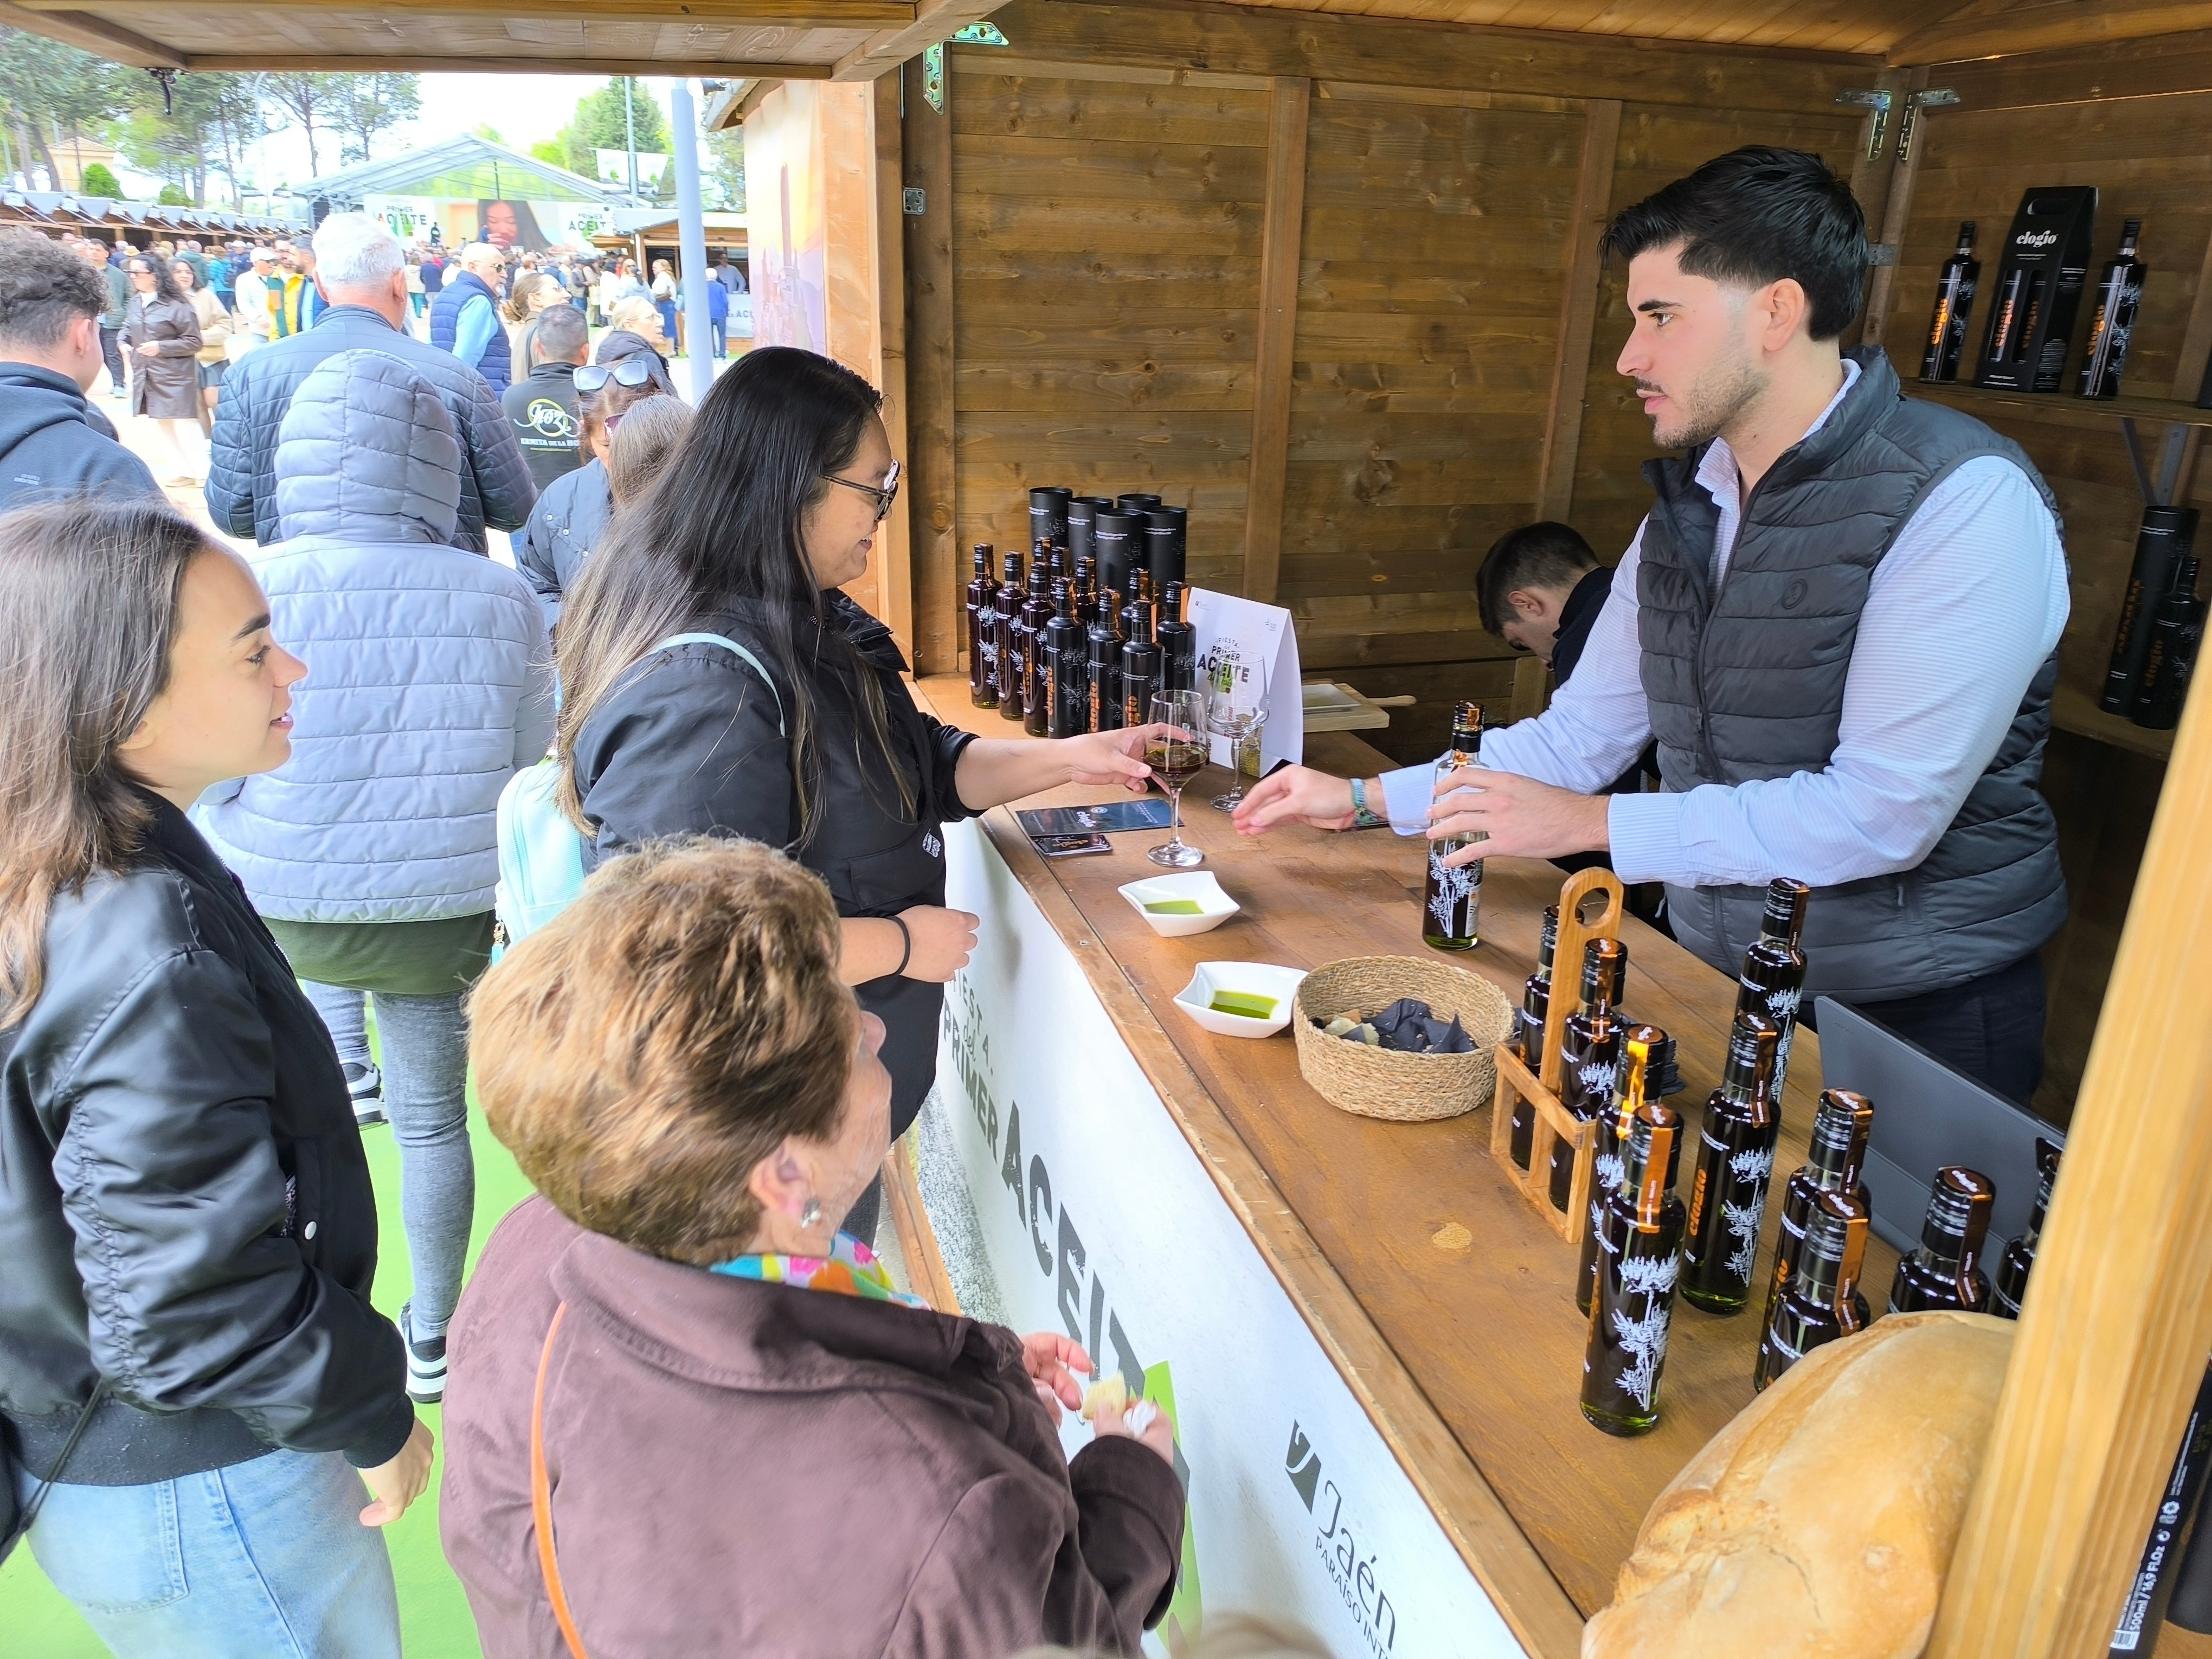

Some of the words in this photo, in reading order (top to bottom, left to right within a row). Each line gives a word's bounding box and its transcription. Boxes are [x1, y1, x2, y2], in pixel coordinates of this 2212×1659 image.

[568, 220, 607, 232] ACEIT
[2016, 230, 2058, 248] elogio
[1211, 645, 1240, 662] PRIMER
[944, 996, 998, 1165] PRIMER
[1690, 1168, 1707, 1236] elogio
[1319, 1480, 1396, 1652] Jaén
